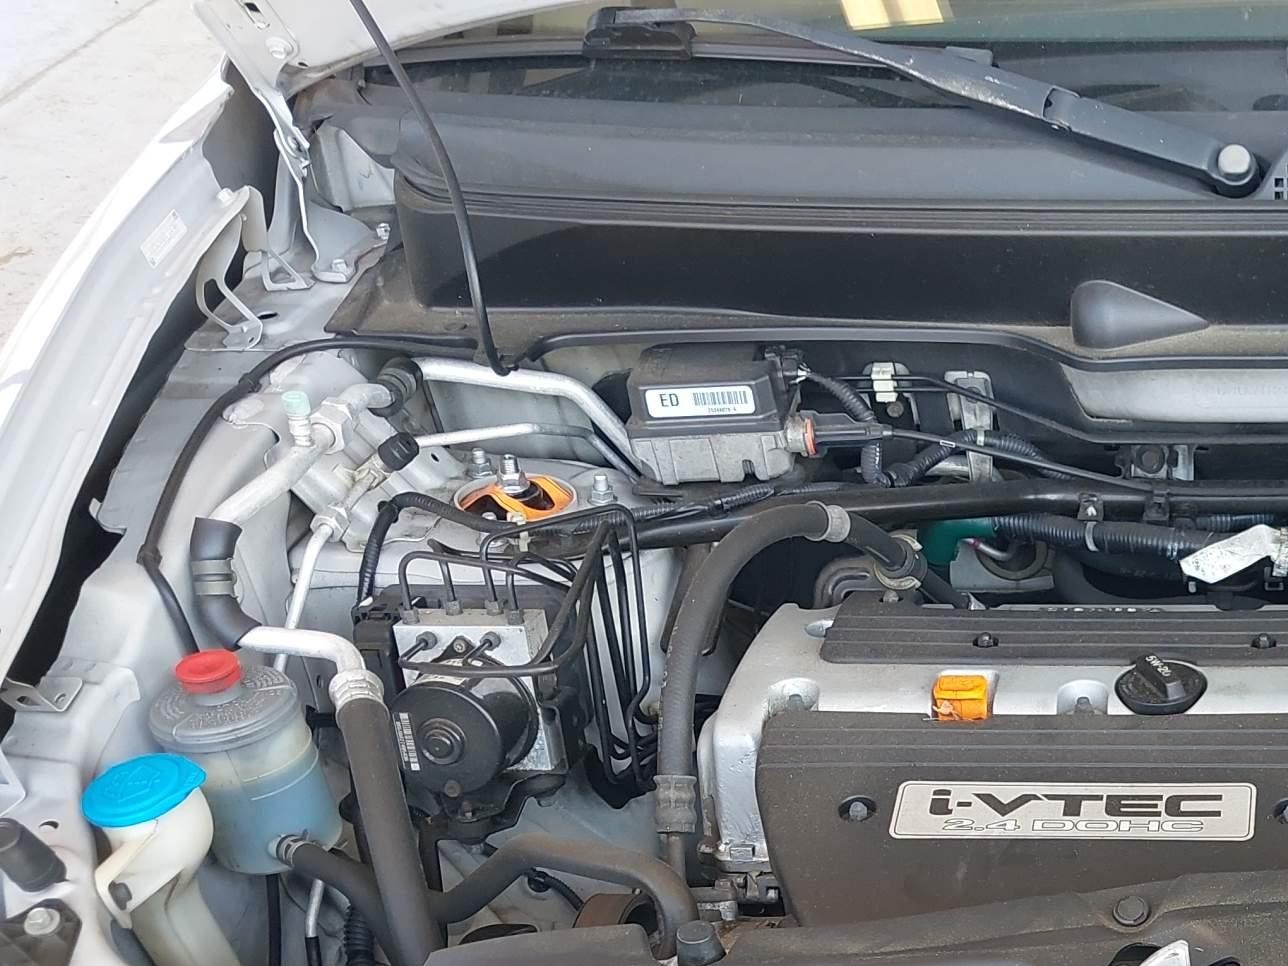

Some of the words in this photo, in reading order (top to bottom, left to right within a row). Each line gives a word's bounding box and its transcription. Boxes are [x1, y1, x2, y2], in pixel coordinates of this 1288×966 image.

[659, 393, 680, 407] ED
[1145, 655, 1173, 677] 5W-20
[929, 789, 1223, 818] i-VTEC
[942, 818, 1021, 832] 2.4
[1031, 818, 1204, 833] DOHC
